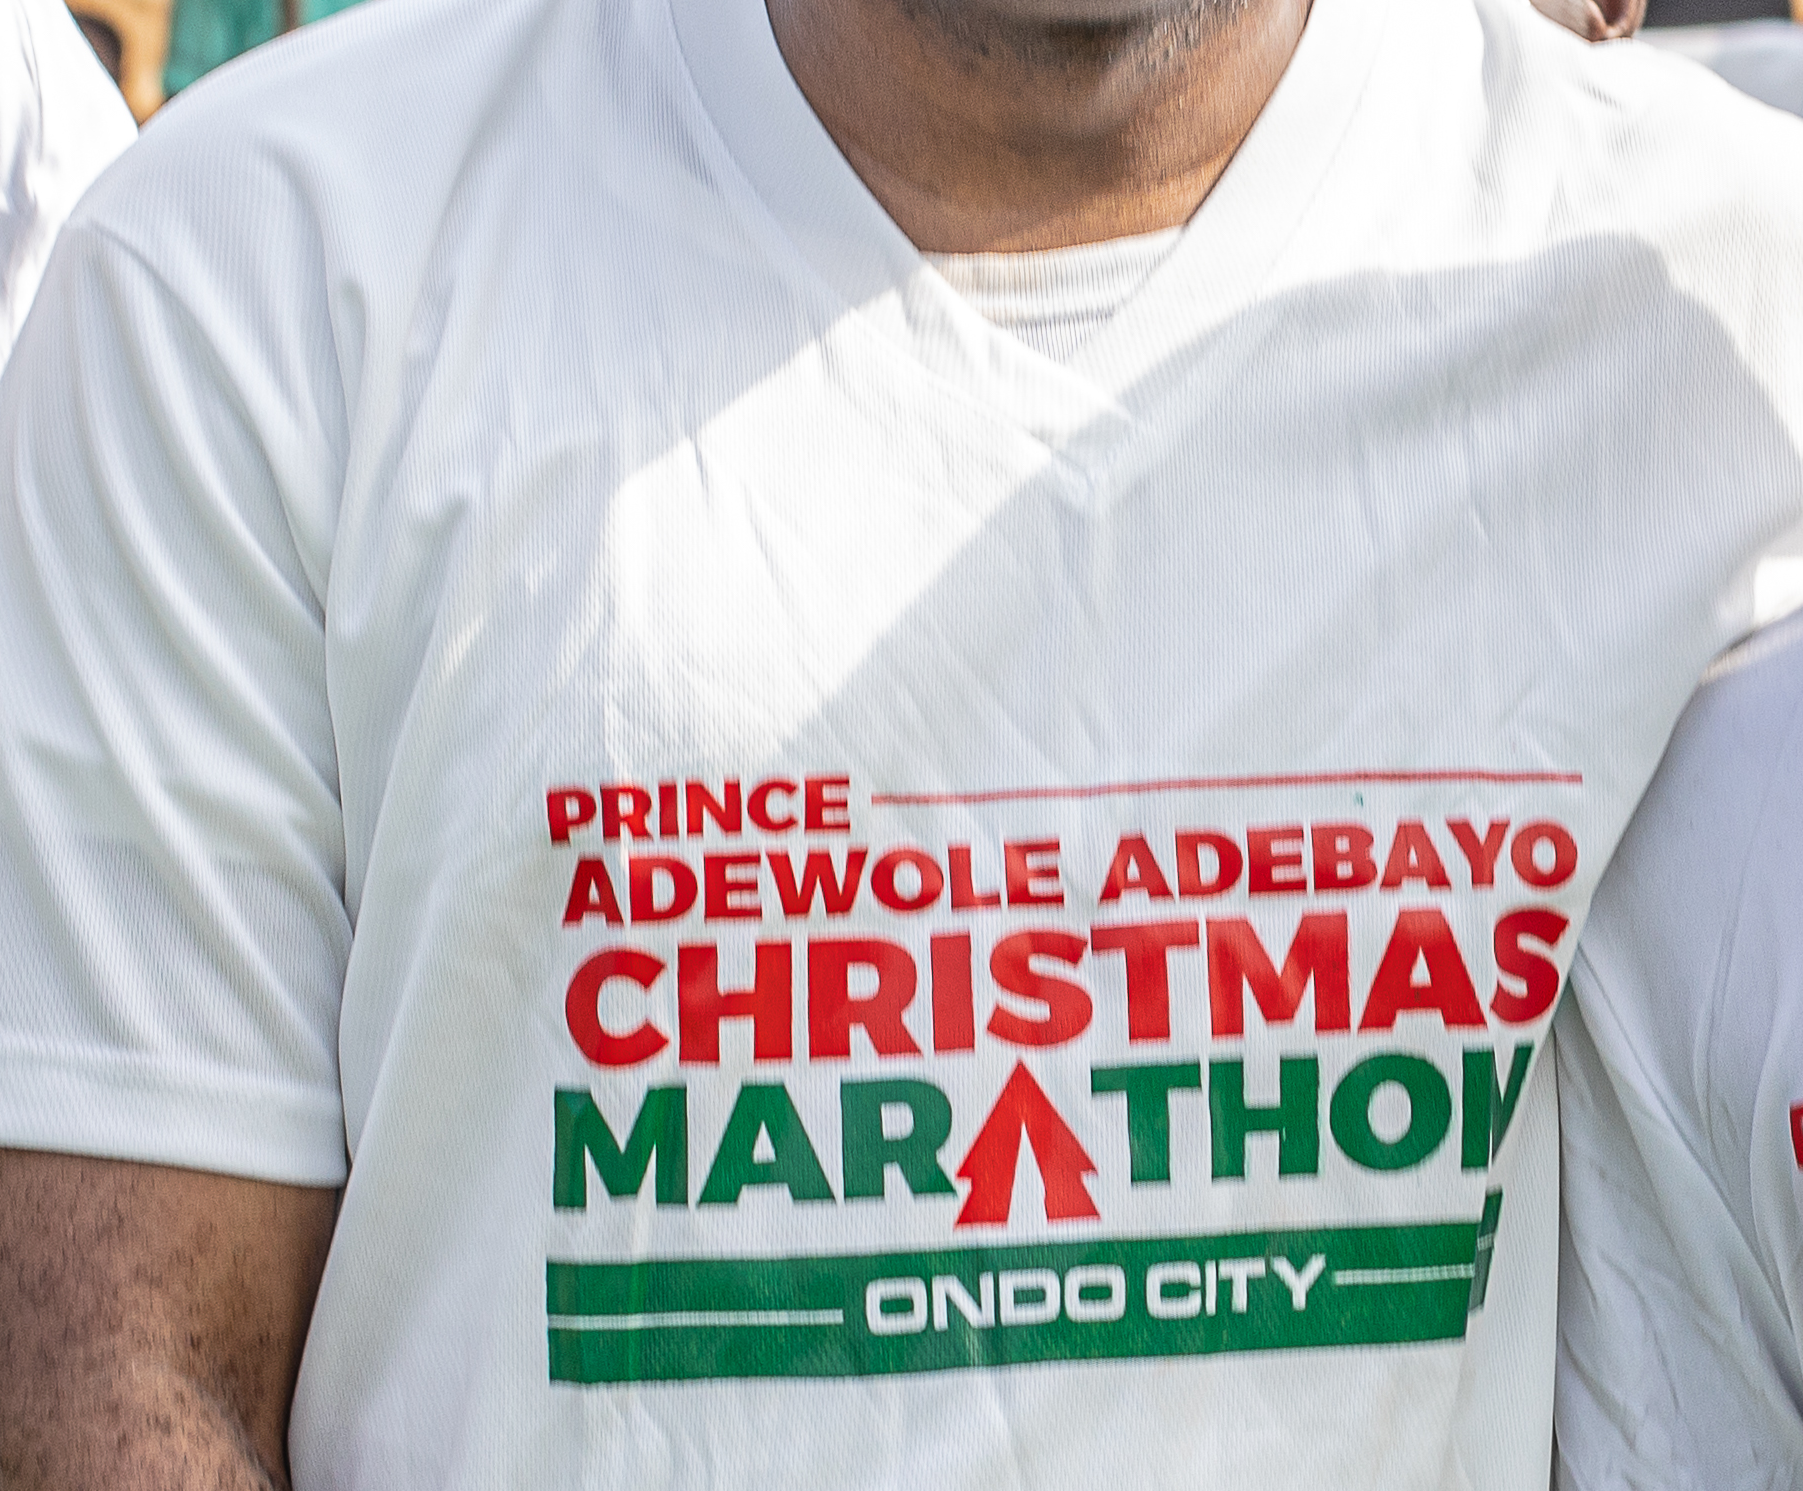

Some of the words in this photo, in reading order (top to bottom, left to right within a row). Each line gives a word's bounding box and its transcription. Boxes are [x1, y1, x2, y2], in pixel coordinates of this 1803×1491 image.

[546, 774, 851, 846] PRINCE
[562, 835, 1065, 928] ADEWOLE
[1099, 816, 1579, 906] ADEBAYO
[564, 904, 1570, 1070] CHRISTMAS
[865, 1265, 1126, 1336] ONDO
[1146, 1252, 1327, 1320] CITY
